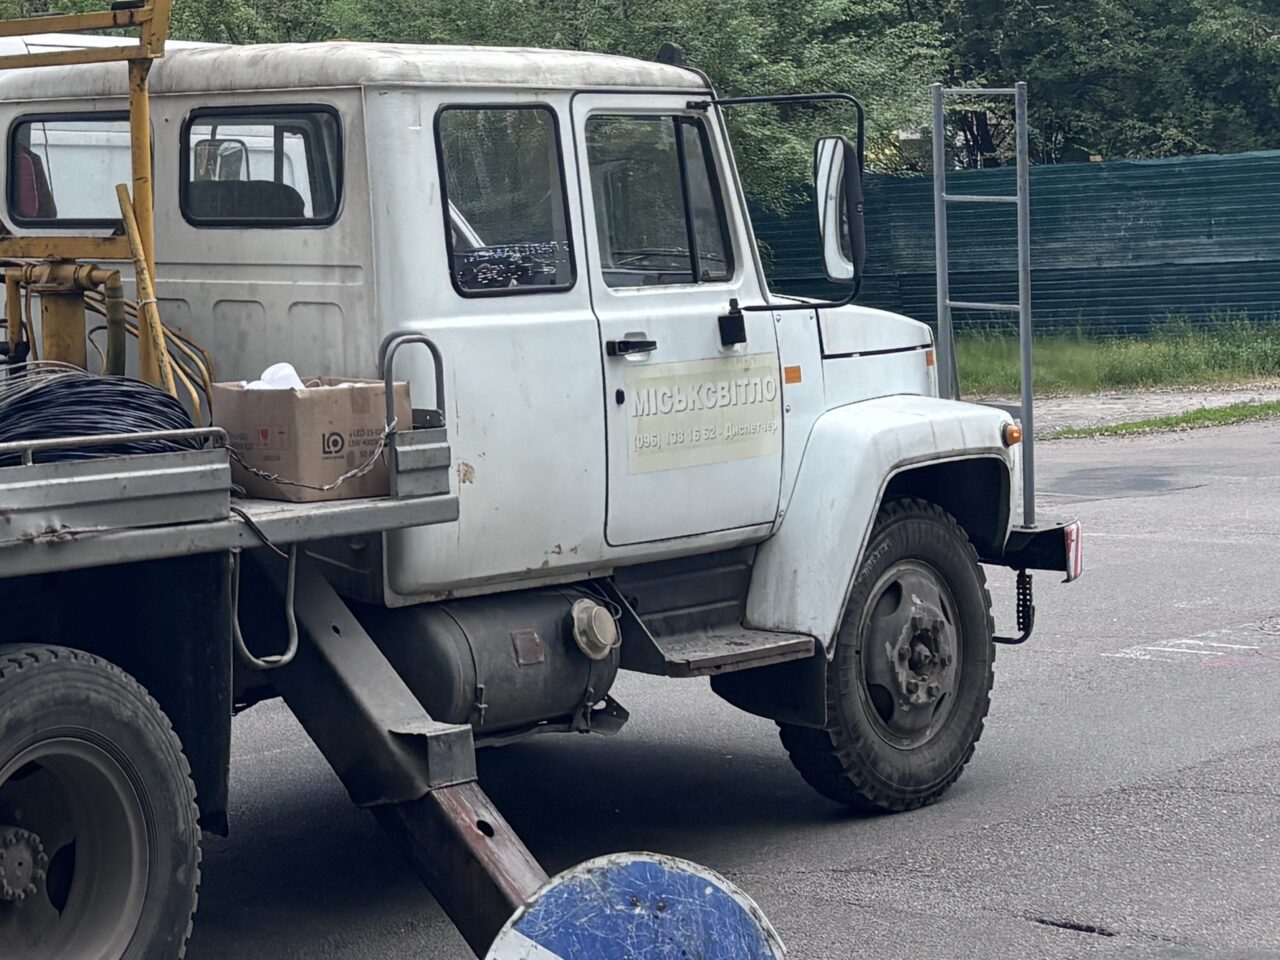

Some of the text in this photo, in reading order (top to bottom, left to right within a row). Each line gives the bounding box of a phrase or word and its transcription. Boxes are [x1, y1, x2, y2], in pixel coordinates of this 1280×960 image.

[632, 375, 778, 417] МІСЬКСВІТЛО
[634, 432, 661, 451] (096)
[724, 420, 778, 441] Диспетчер
